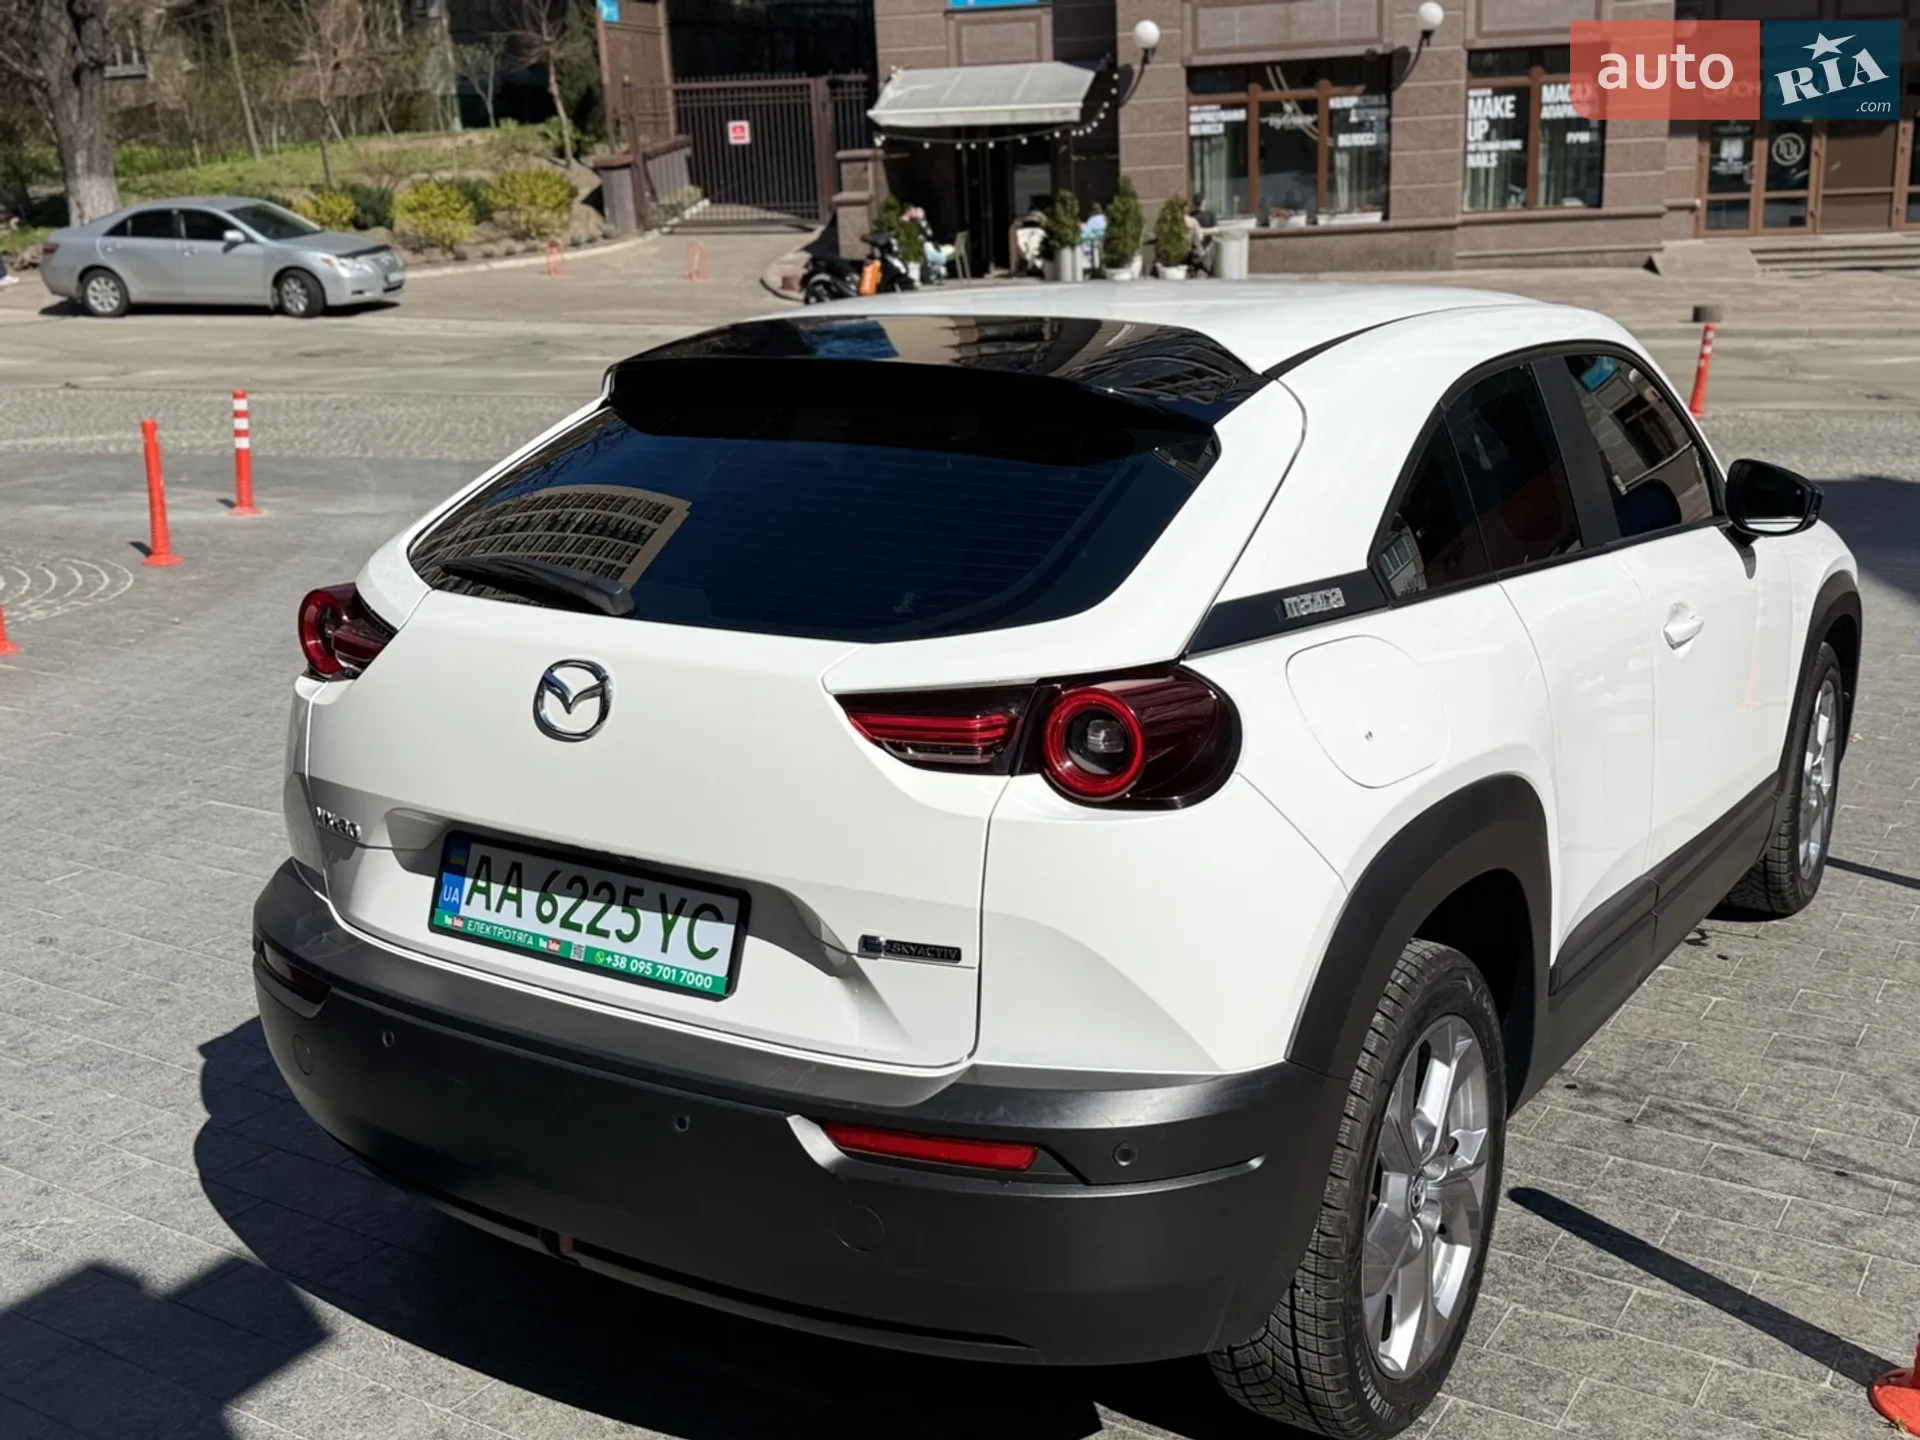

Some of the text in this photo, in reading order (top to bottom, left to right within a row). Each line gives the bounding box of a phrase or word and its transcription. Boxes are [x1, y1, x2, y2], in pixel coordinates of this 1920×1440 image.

[1468, 94, 1516, 119] MAKE
[1467, 119, 1490, 141] UP
[1467, 151, 1498, 168] NAILS
[443, 884, 459, 904] UA
[465, 855, 724, 960] AA 6225 YC
[467, 920, 534, 946] ЕЛЕКТРОТЯГА
[605, 954, 712, 989] +38 095 701 7000
